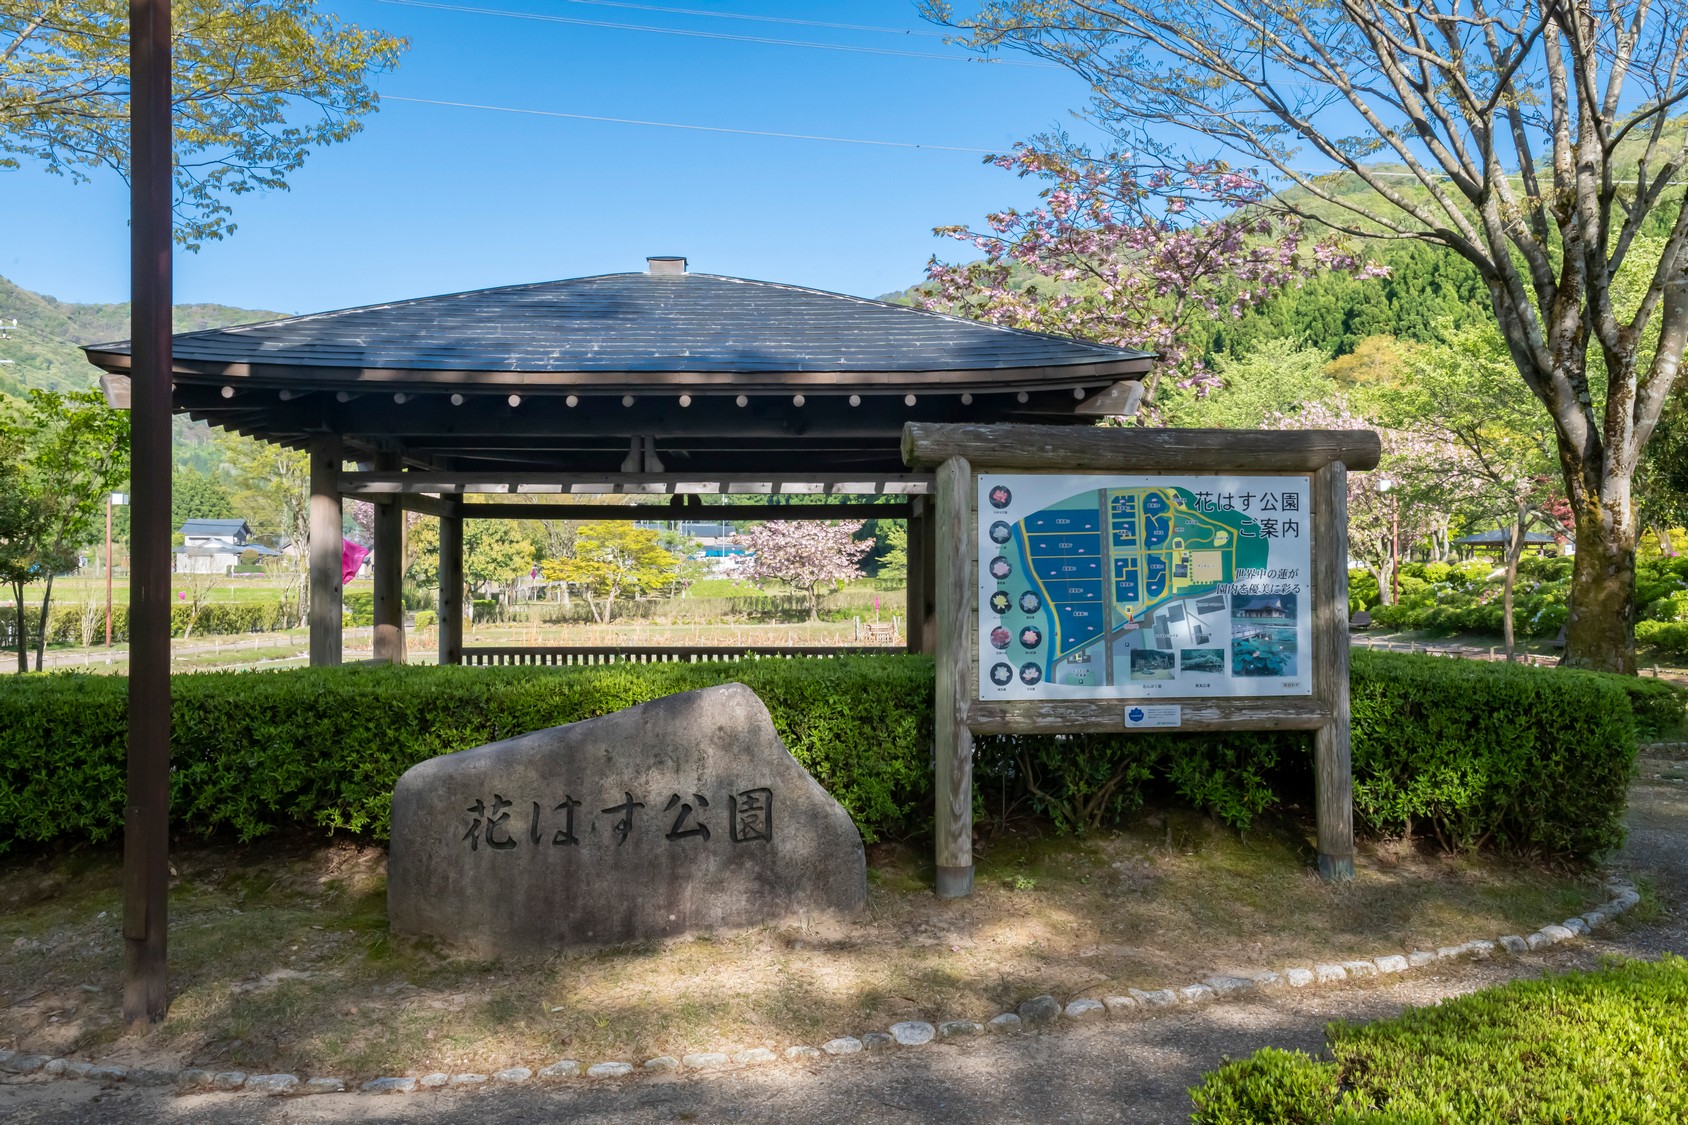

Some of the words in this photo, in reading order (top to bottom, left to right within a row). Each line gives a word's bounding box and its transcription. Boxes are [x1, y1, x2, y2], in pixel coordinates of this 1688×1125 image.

[1194, 491, 1299, 512] 花はす公園
[1239, 518, 1299, 538] ご案内
[1235, 568, 1299, 580] 世界中の蓮が
[1216, 583, 1301, 595] 園内を優美に彩る
[460, 787, 774, 852] 花はす公園
